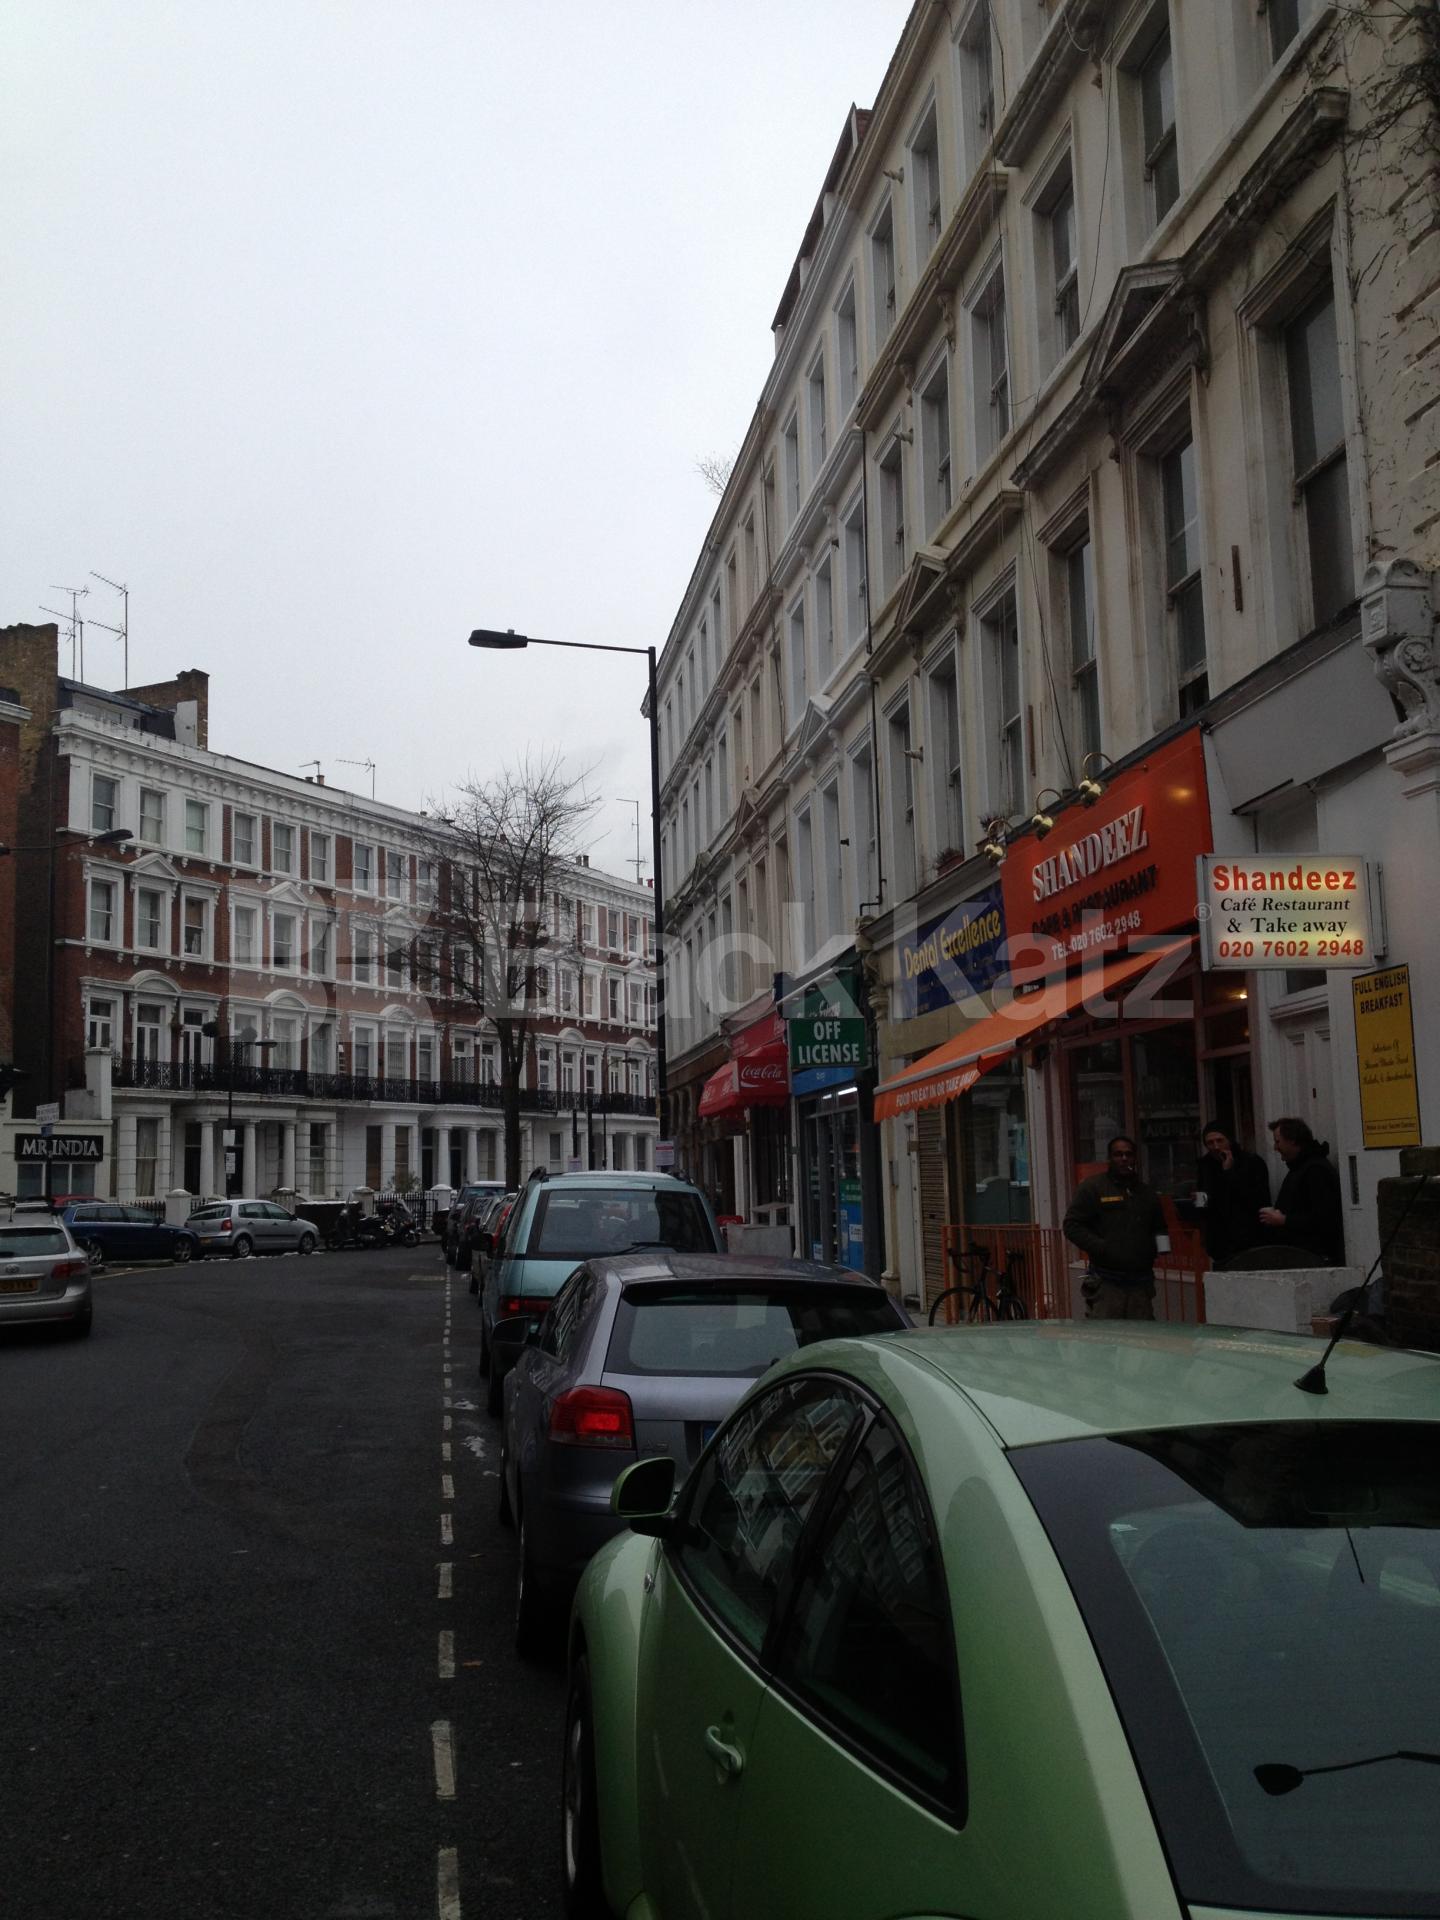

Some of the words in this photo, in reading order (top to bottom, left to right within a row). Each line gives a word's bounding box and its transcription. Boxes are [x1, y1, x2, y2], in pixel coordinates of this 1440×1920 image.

[1032, 804, 1149, 903] SHANDEEZ
[1213, 865, 1357, 891] Shandeez
[1220, 897, 1257, 912] Café
[1262, 896, 1350, 912] Restaurant
[1088, 922, 1115, 947] 7602
[1114, 910, 1141, 936] 2948
[1227, 918, 1242, 933] &
[1250, 917, 1298, 934] Take
[1302, 921, 1348, 937] away
[903, 932, 939, 980] Dental
[940, 909, 1001, 961] Excellence
[1219, 941, 1254, 958] 020
[1262, 941, 1309, 957] 7602
[1316, 939, 1365, 956] 2948
[1354, 979, 1373, 996] FULL
[1374, 971, 1408, 992] ENGLISH
[1360, 992, 1404, 1014] BREAKFAST
[813, 1021, 841, 1040] OFF
[798, 1043, 861, 1065] LICENSE
[896, 1091, 910, 1107] FOOD
[911, 1089, 919, 1103] TO
[919, 1086, 930, 1102] EAT
[929, 1084, 937, 1097] IN
[936, 1081, 945, 1097] OR
[945, 1074, 961, 1091] TAKE
[51, 1139, 100, 1157] INDIA
